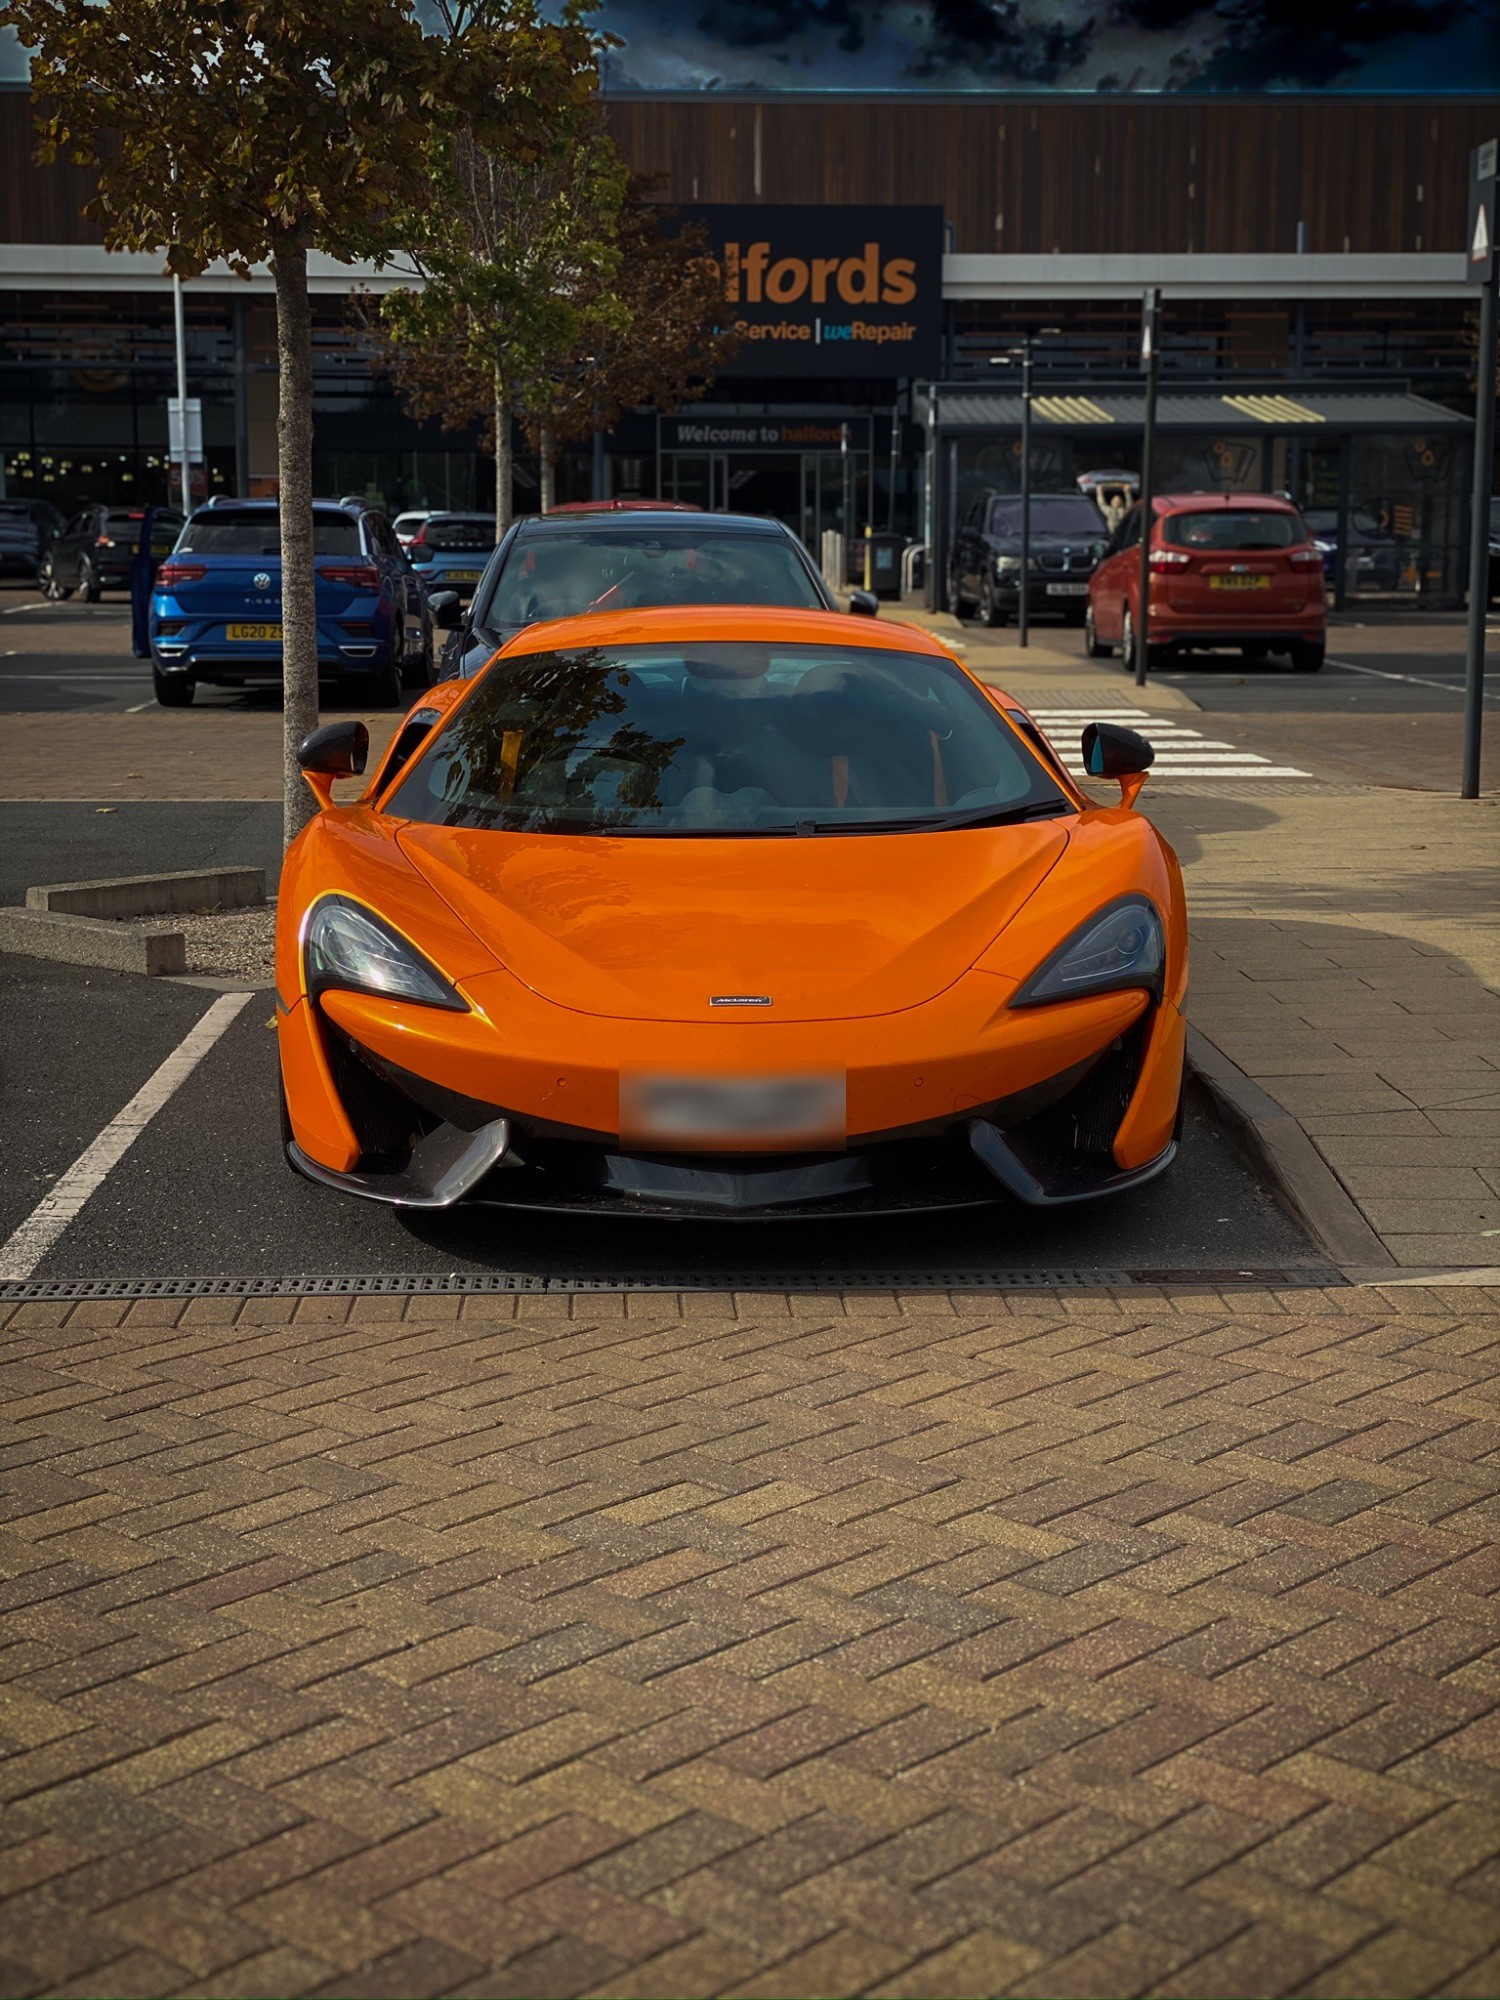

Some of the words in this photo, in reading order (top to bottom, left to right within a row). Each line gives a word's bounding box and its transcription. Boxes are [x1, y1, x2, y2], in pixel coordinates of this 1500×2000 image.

[823, 320, 917, 345] weRepair
[677, 425, 757, 443] Welcome
[760, 425, 780, 443] to
[232, 625, 266, 639] LG20
